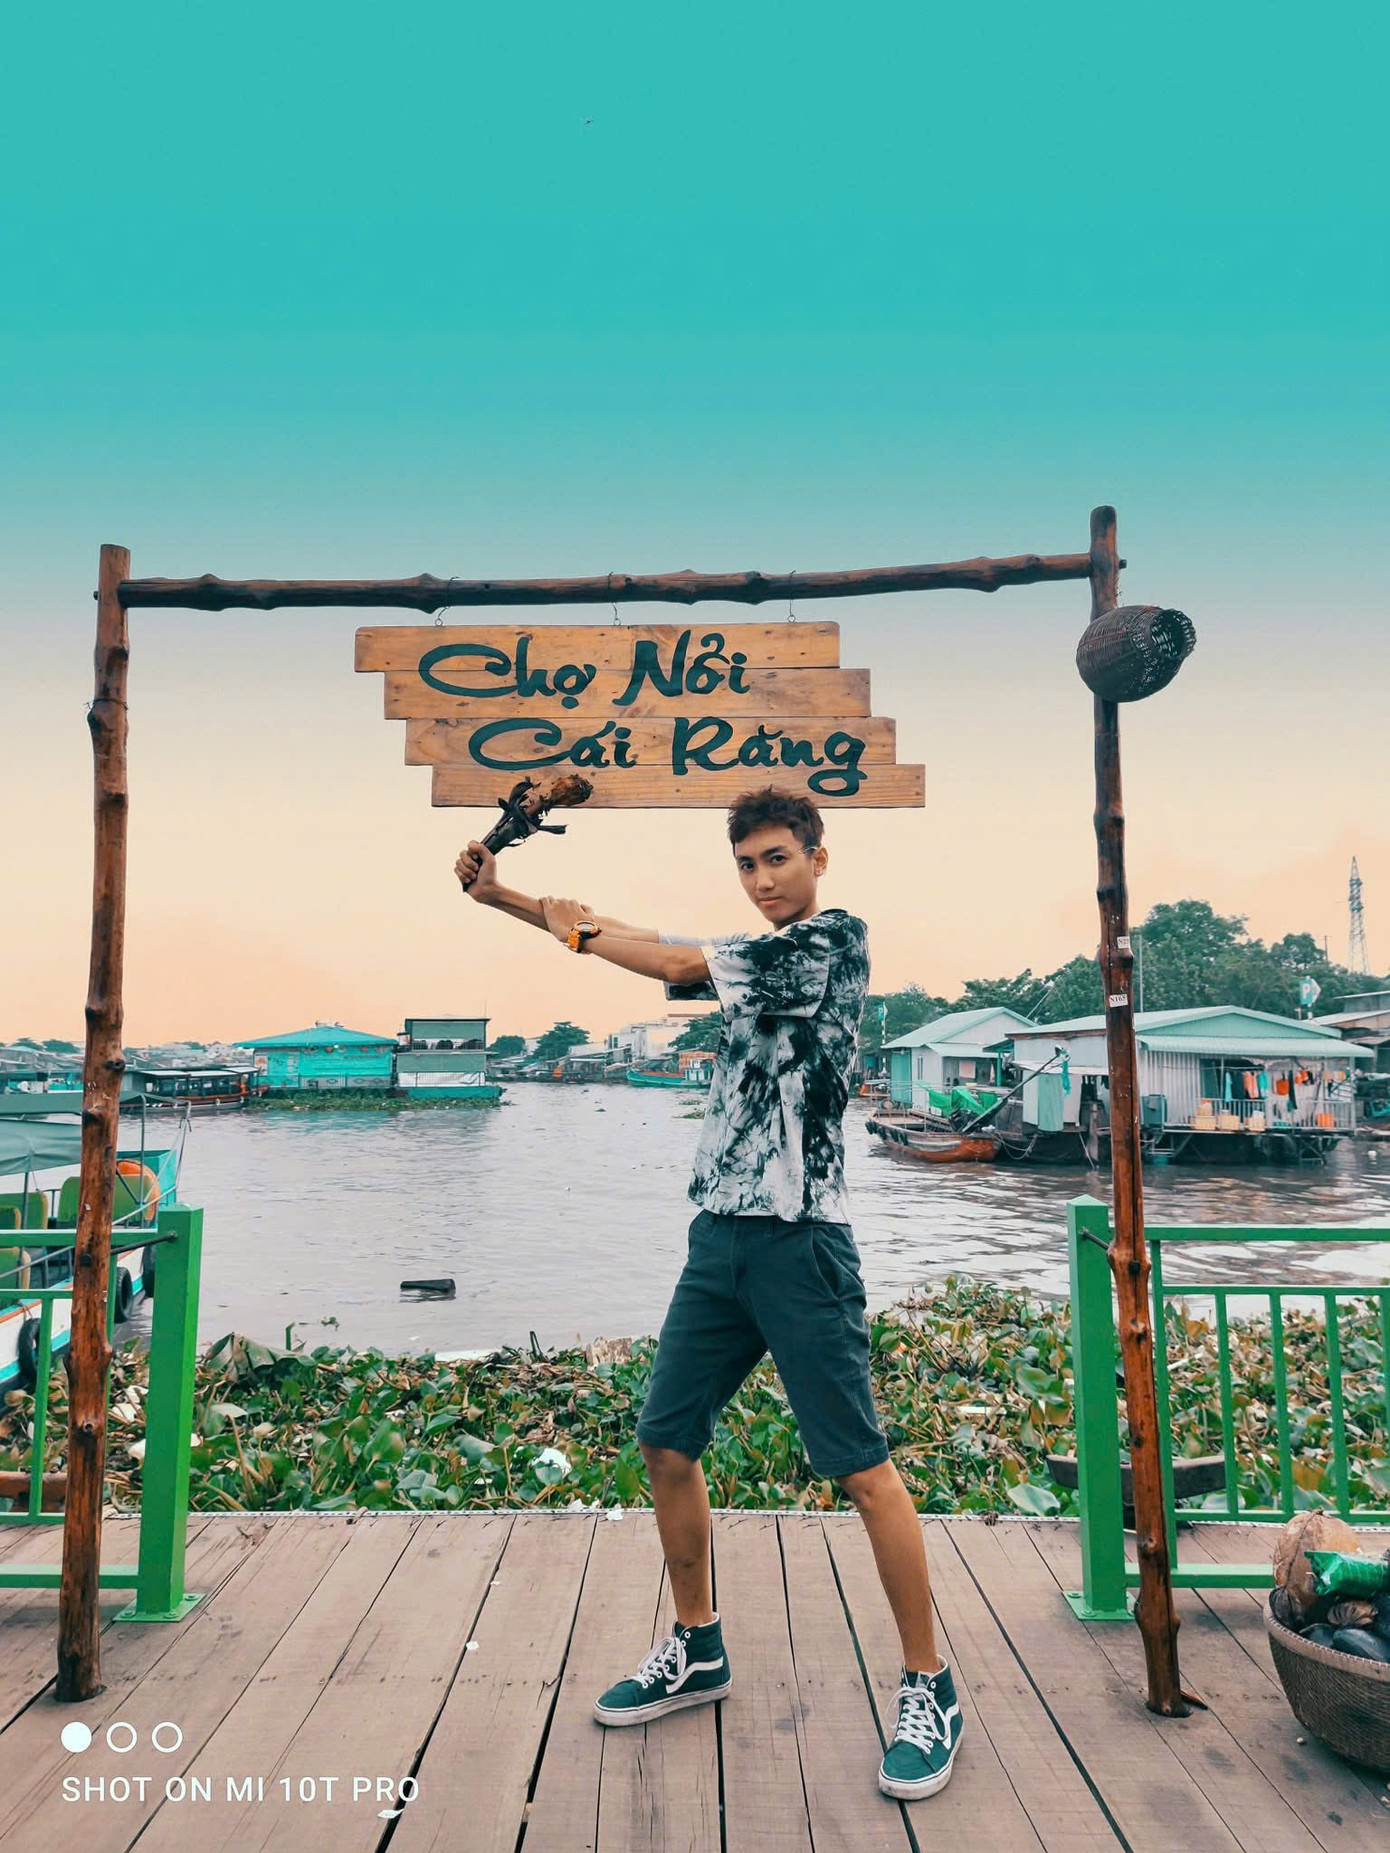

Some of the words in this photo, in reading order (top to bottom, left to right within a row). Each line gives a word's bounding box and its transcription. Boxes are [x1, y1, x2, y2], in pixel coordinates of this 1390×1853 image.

[419, 637, 597, 709] Chợ
[613, 629, 752, 707] Nổi
[469, 719, 637, 771] Cái
[672, 717, 868, 797] Răng
[1109, 995, 1126, 1003] N165
